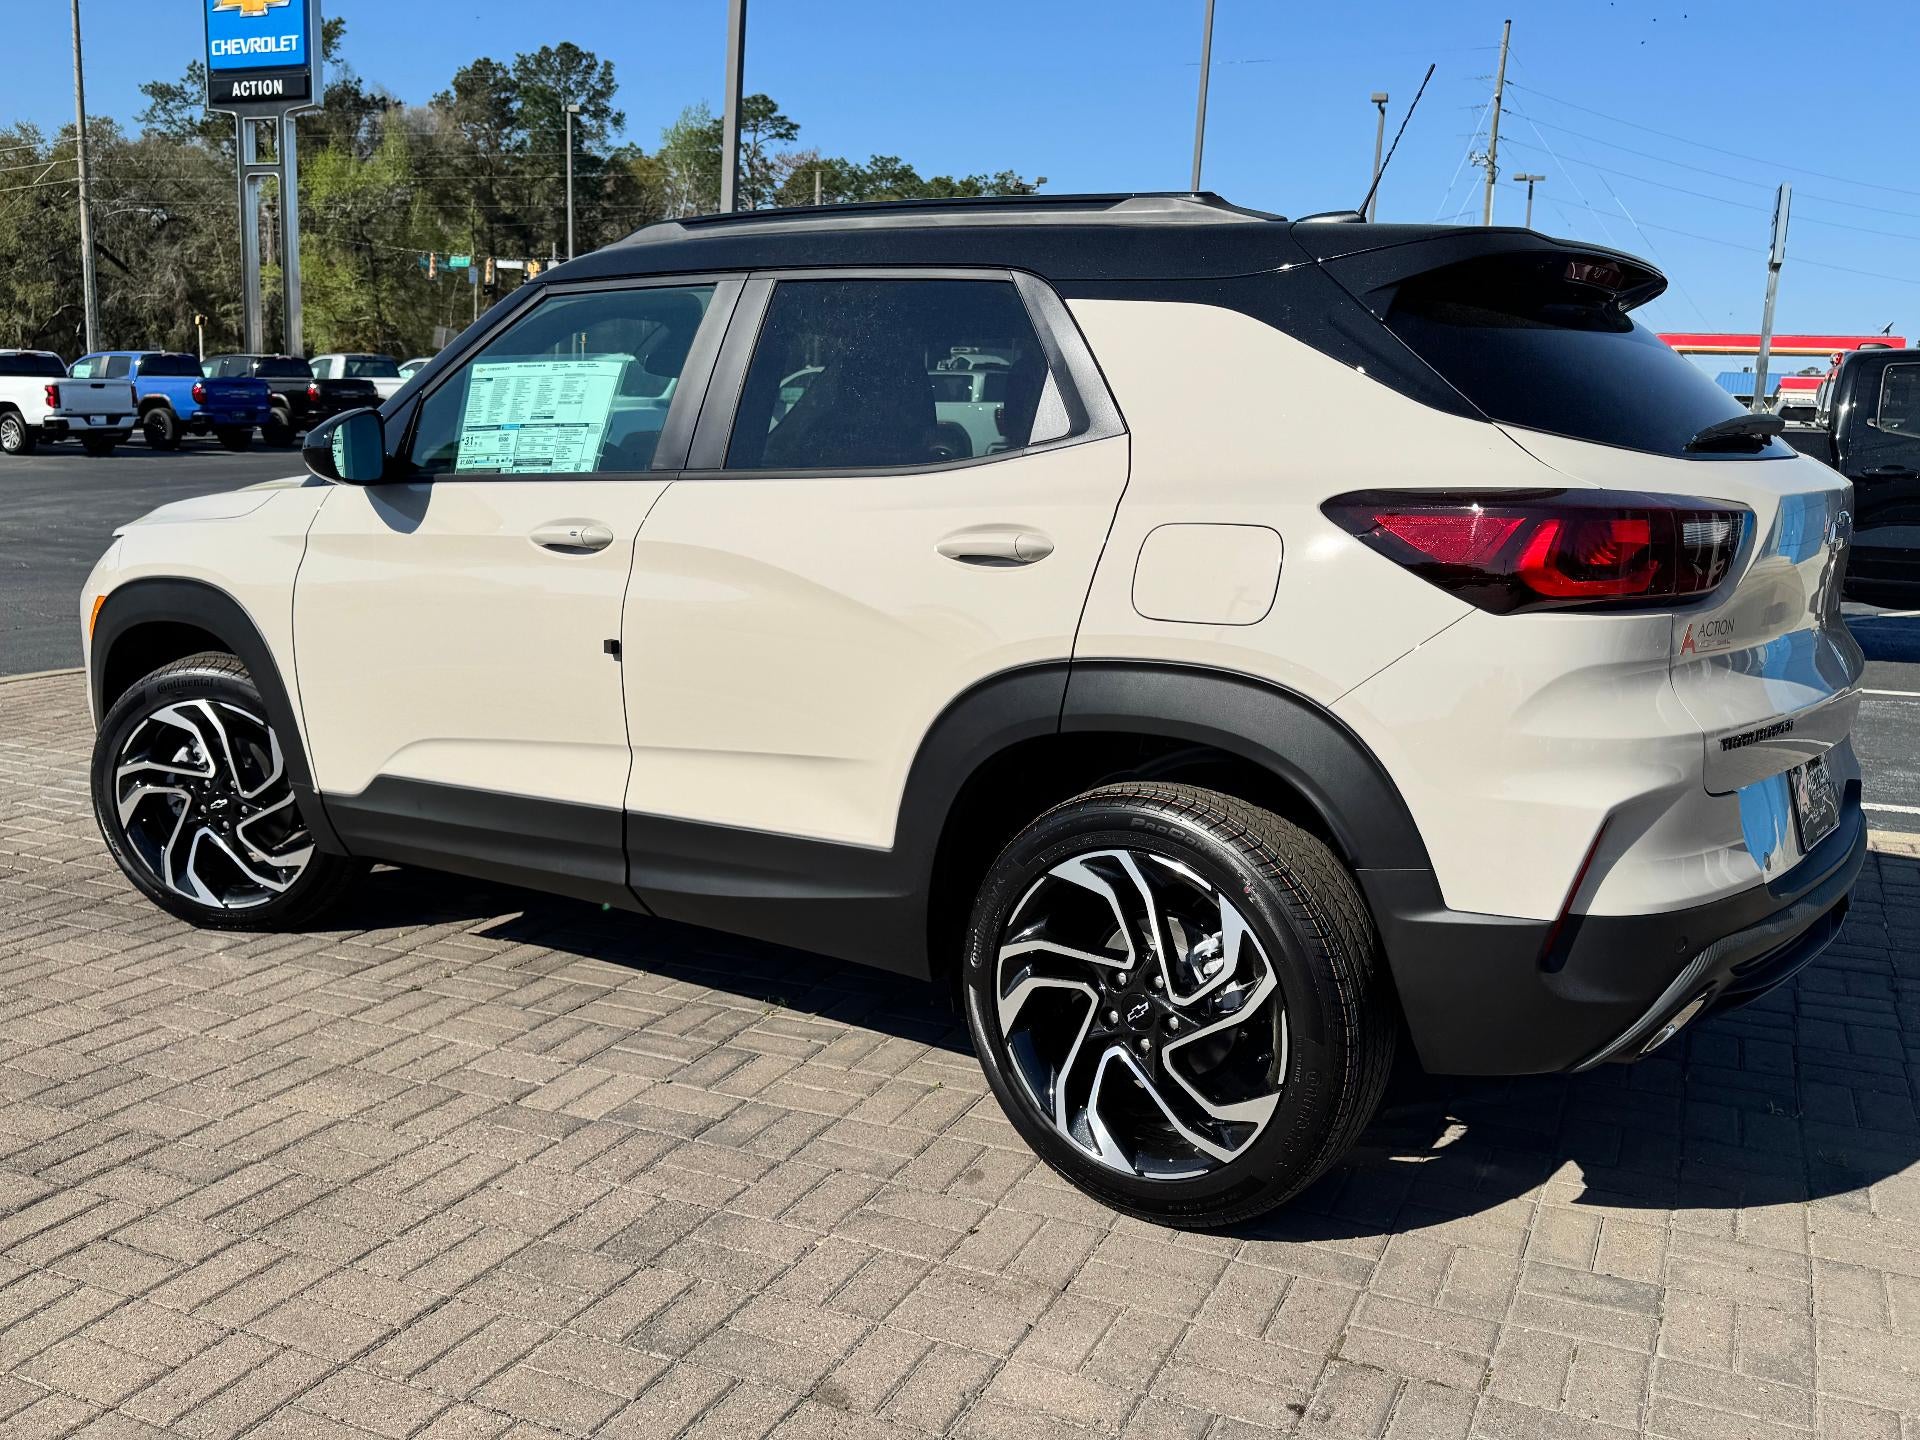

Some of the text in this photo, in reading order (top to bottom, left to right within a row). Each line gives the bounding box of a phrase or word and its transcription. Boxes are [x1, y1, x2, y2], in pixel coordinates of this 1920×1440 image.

[211, 35, 298, 56] CHEVROLET
[232, 79, 283, 97] ACTION
[464, 436, 474, 446] 31
[1697, 618, 1735, 638] ACTION
[157, 678, 213, 693] Continental
